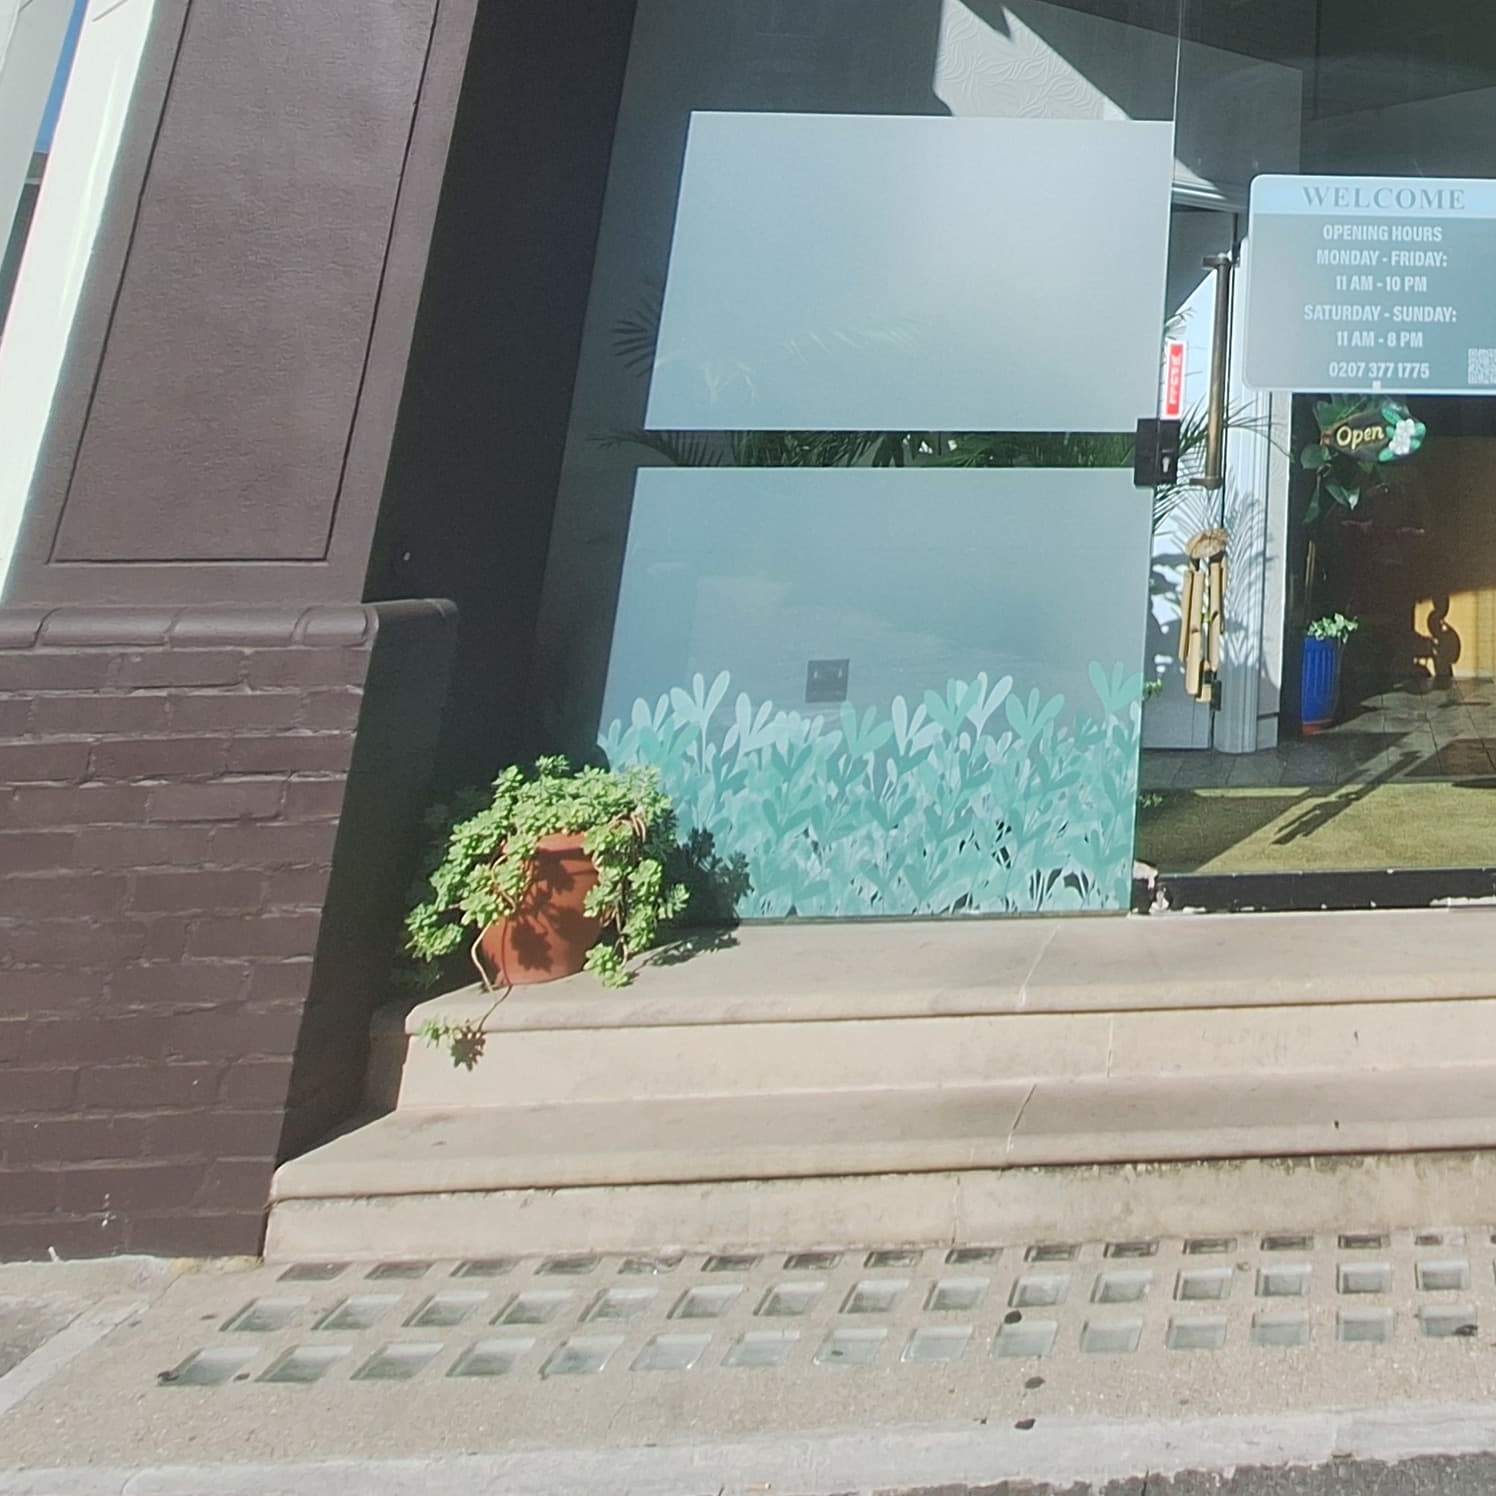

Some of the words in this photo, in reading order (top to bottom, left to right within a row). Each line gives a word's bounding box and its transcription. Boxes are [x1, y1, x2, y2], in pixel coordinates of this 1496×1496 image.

[1303, 186, 1466, 211] WELCOME
[1323, 224, 1388, 241] OPENING
[1391, 225, 1443, 242] HOURS
[1316, 249, 1379, 266] MONDAY
[1391, 251, 1448, 267] FRIDAY:
[1336, 275, 1348, 290] 11
[1351, 276, 1373, 291] AM
[1386, 276, 1401, 292] 10
[1404, 277, 1427, 292] PM
[1303, 304, 1381, 321] SATURDAY
[1393, 306, 1457, 323] SUNDAY:
[1336, 331, 1348, 346] 11
[1351, 331, 1374, 347] AM
[1387, 331, 1397, 347] 8
[1400, 332, 1423, 348] PM
[1329, 361, 1363, 378] 0207
[1368, 362, 1393, 378] 377
[1398, 362, 1430, 379] 1775
[1336, 424, 1385, 450] Open
